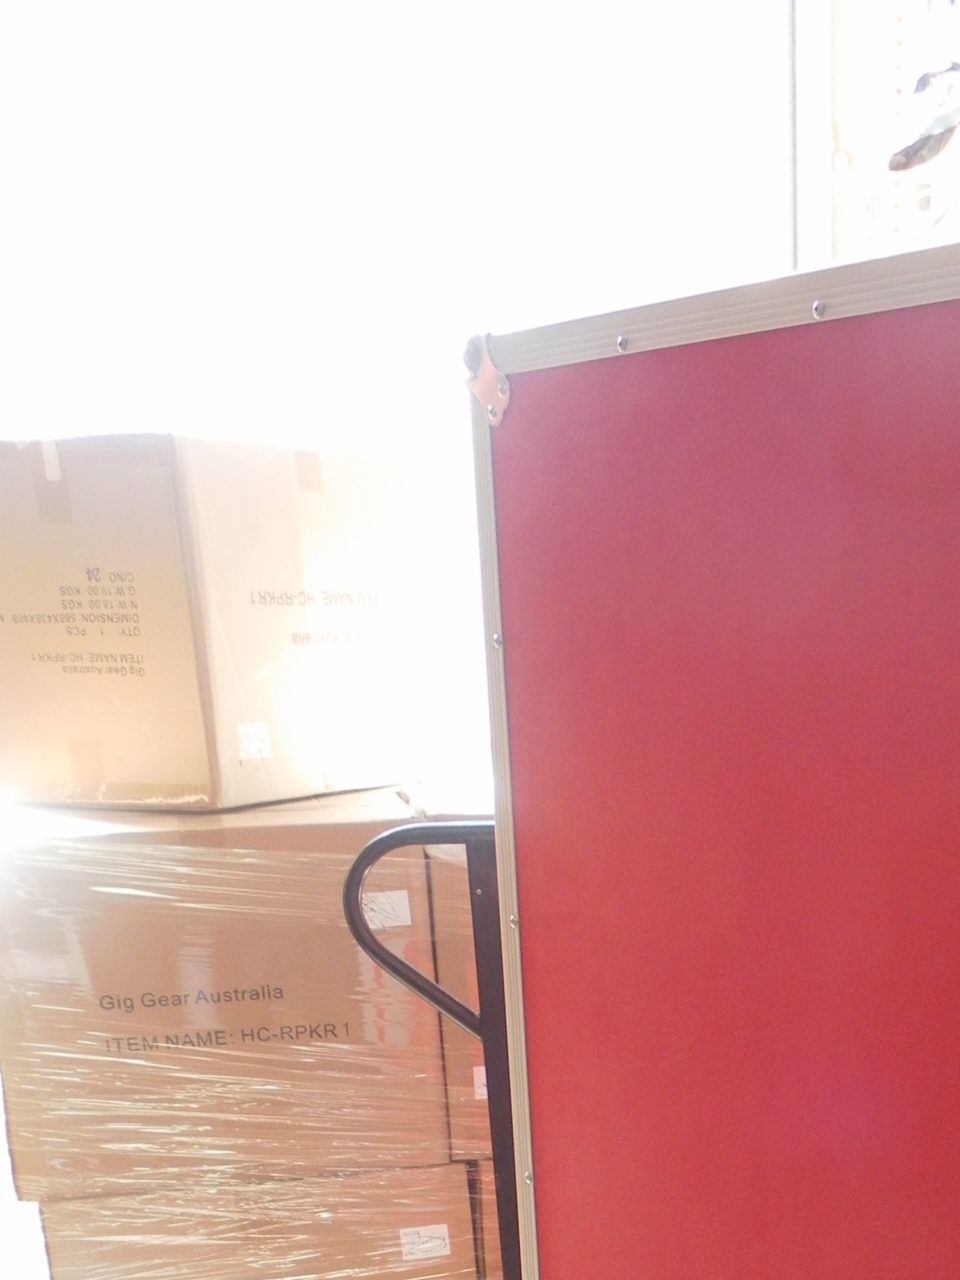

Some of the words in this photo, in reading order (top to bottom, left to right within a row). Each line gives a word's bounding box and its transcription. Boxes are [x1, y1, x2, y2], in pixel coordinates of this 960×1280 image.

[59, 585, 81, 597] KGS
[61, 599, 82, 610] KGS
[65, 626, 87, 637] PCS
[120, 653, 144, 664] ITEM
[62, 665, 103, 675] Australia
[105, 665, 128, 677] Gear
[129, 665, 146, 677] Gig
[99, 994, 135, 1013] Gig
[140, 991, 190, 1009] Gear
[195, 984, 285, 1005] Australia
[105, 1036, 162, 1054] ITEM
[166, 1030, 236, 1051] NAME:
[240, 1022, 338, 1043] HC-RPKR
[342, 1021, 351, 1037] 1
